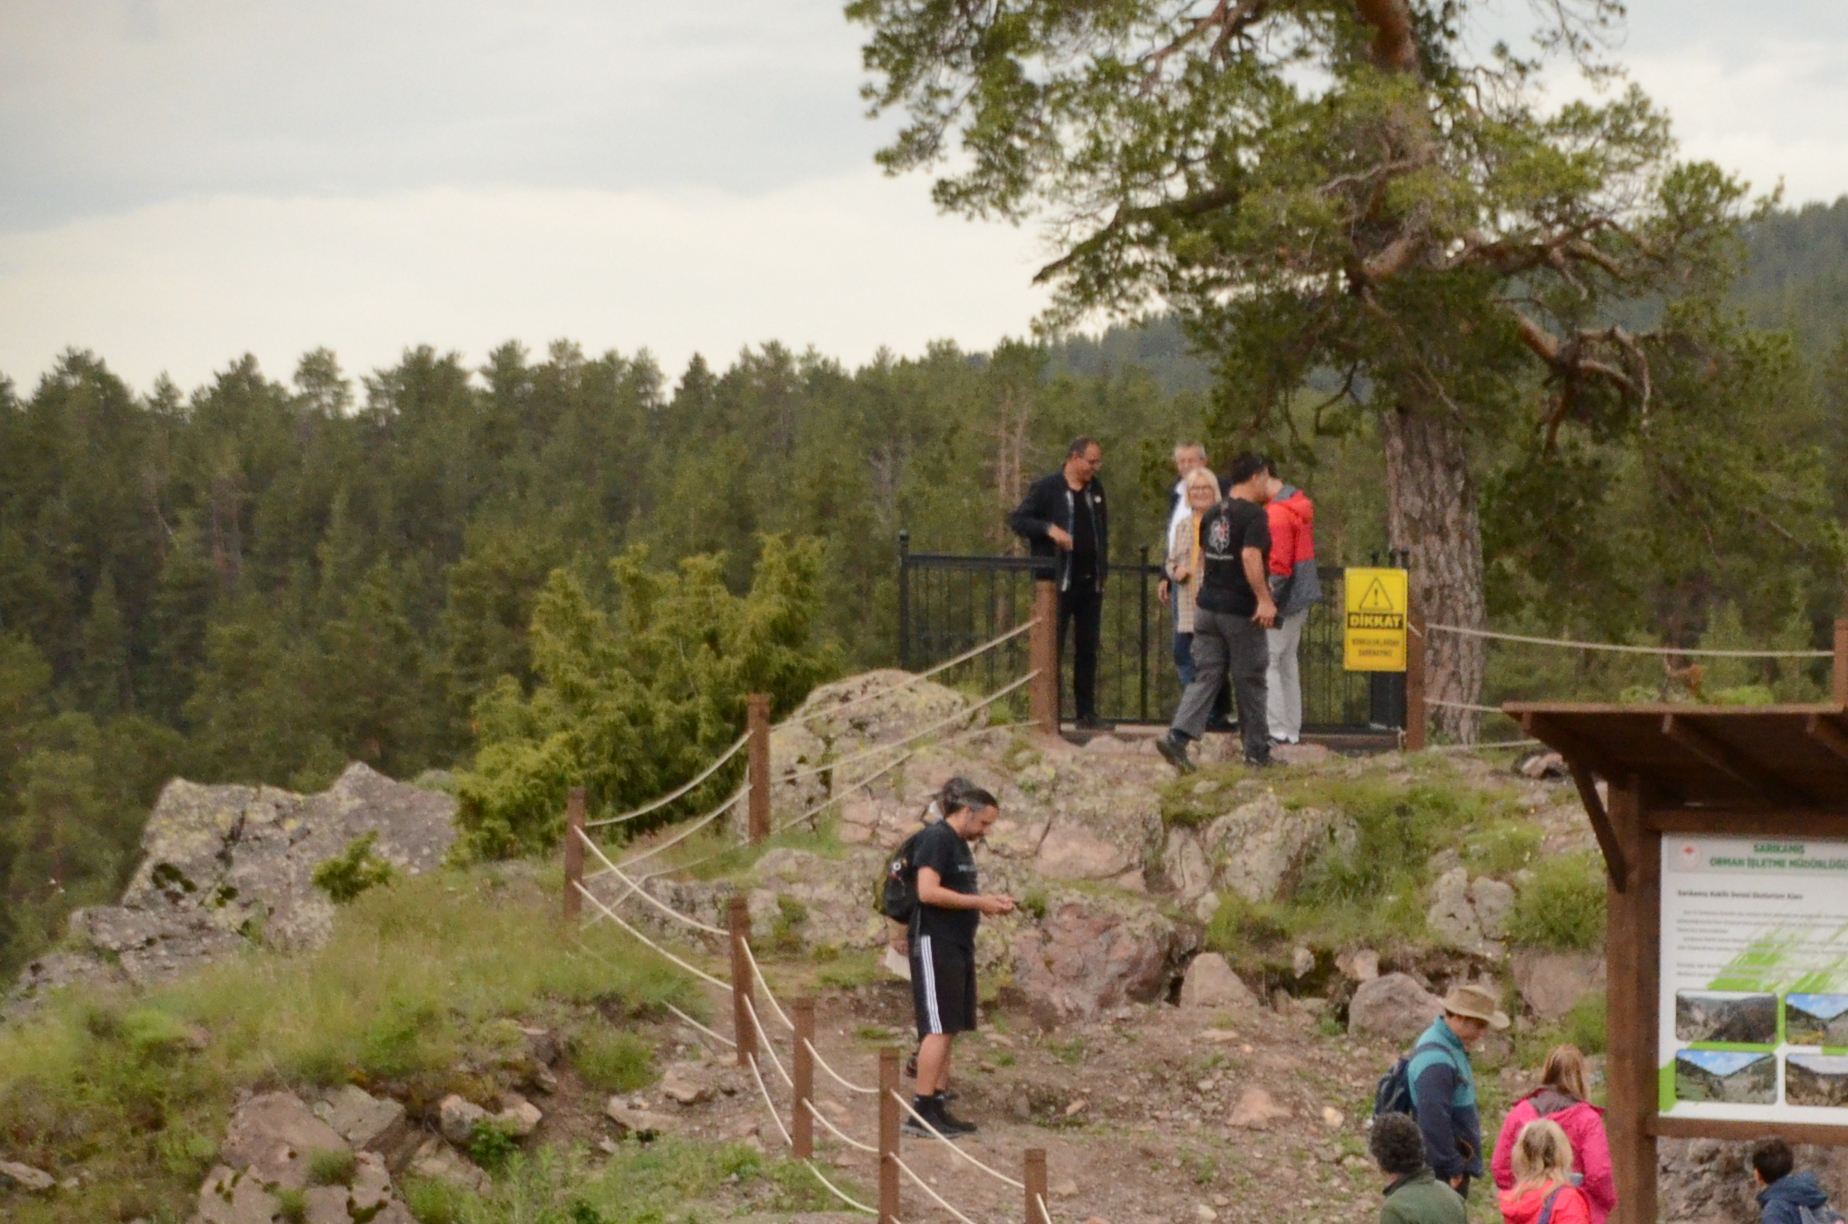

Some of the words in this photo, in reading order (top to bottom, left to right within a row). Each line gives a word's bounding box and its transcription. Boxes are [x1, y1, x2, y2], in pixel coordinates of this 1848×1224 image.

[1350, 614, 1400, 627] DİKKAT
[1754, 844, 1805, 854] SARIKAMIŞ
[1710, 857, 1745, 868] ORMAN
[1748, 857, 1786, 870] İŞLETME
